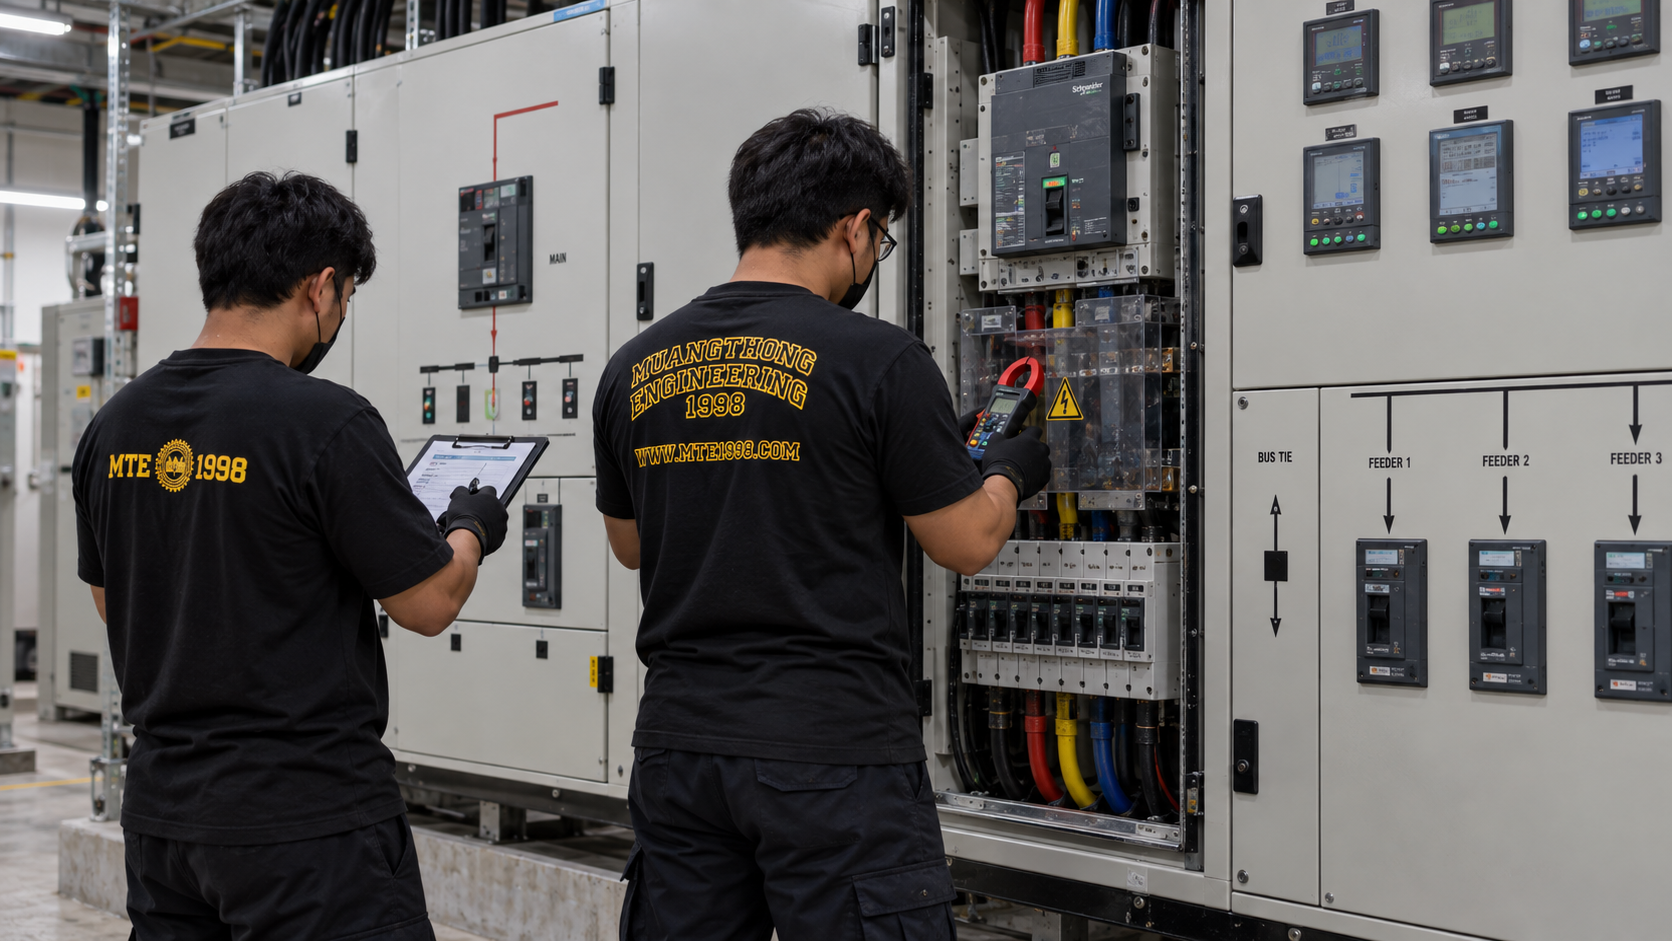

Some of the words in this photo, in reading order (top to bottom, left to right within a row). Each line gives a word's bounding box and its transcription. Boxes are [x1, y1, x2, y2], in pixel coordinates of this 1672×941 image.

[549, 252, 567, 264] MAIN
[630, 336, 818, 390] MUANGTHONG
[629, 363, 809, 422] ENGINEERING
[685, 391, 746, 419] 1998
[634, 440, 801, 468] WWW.MTE1998.COM
[1257, 451, 1276, 464] BUS
[1278, 451, 1293, 463] TIE
[1368, 456, 1403, 469] FEEDER
[1406, 456, 1411, 468] 1
[1482, 455, 1520, 467] FEEDER
[1523, 454, 1530, 466] 2
[1610, 452, 1652, 465] FEEDER
[1655, 451, 1663, 465] 3
[107, 454, 152, 479] MTE
[195, 454, 248, 484] 1998
